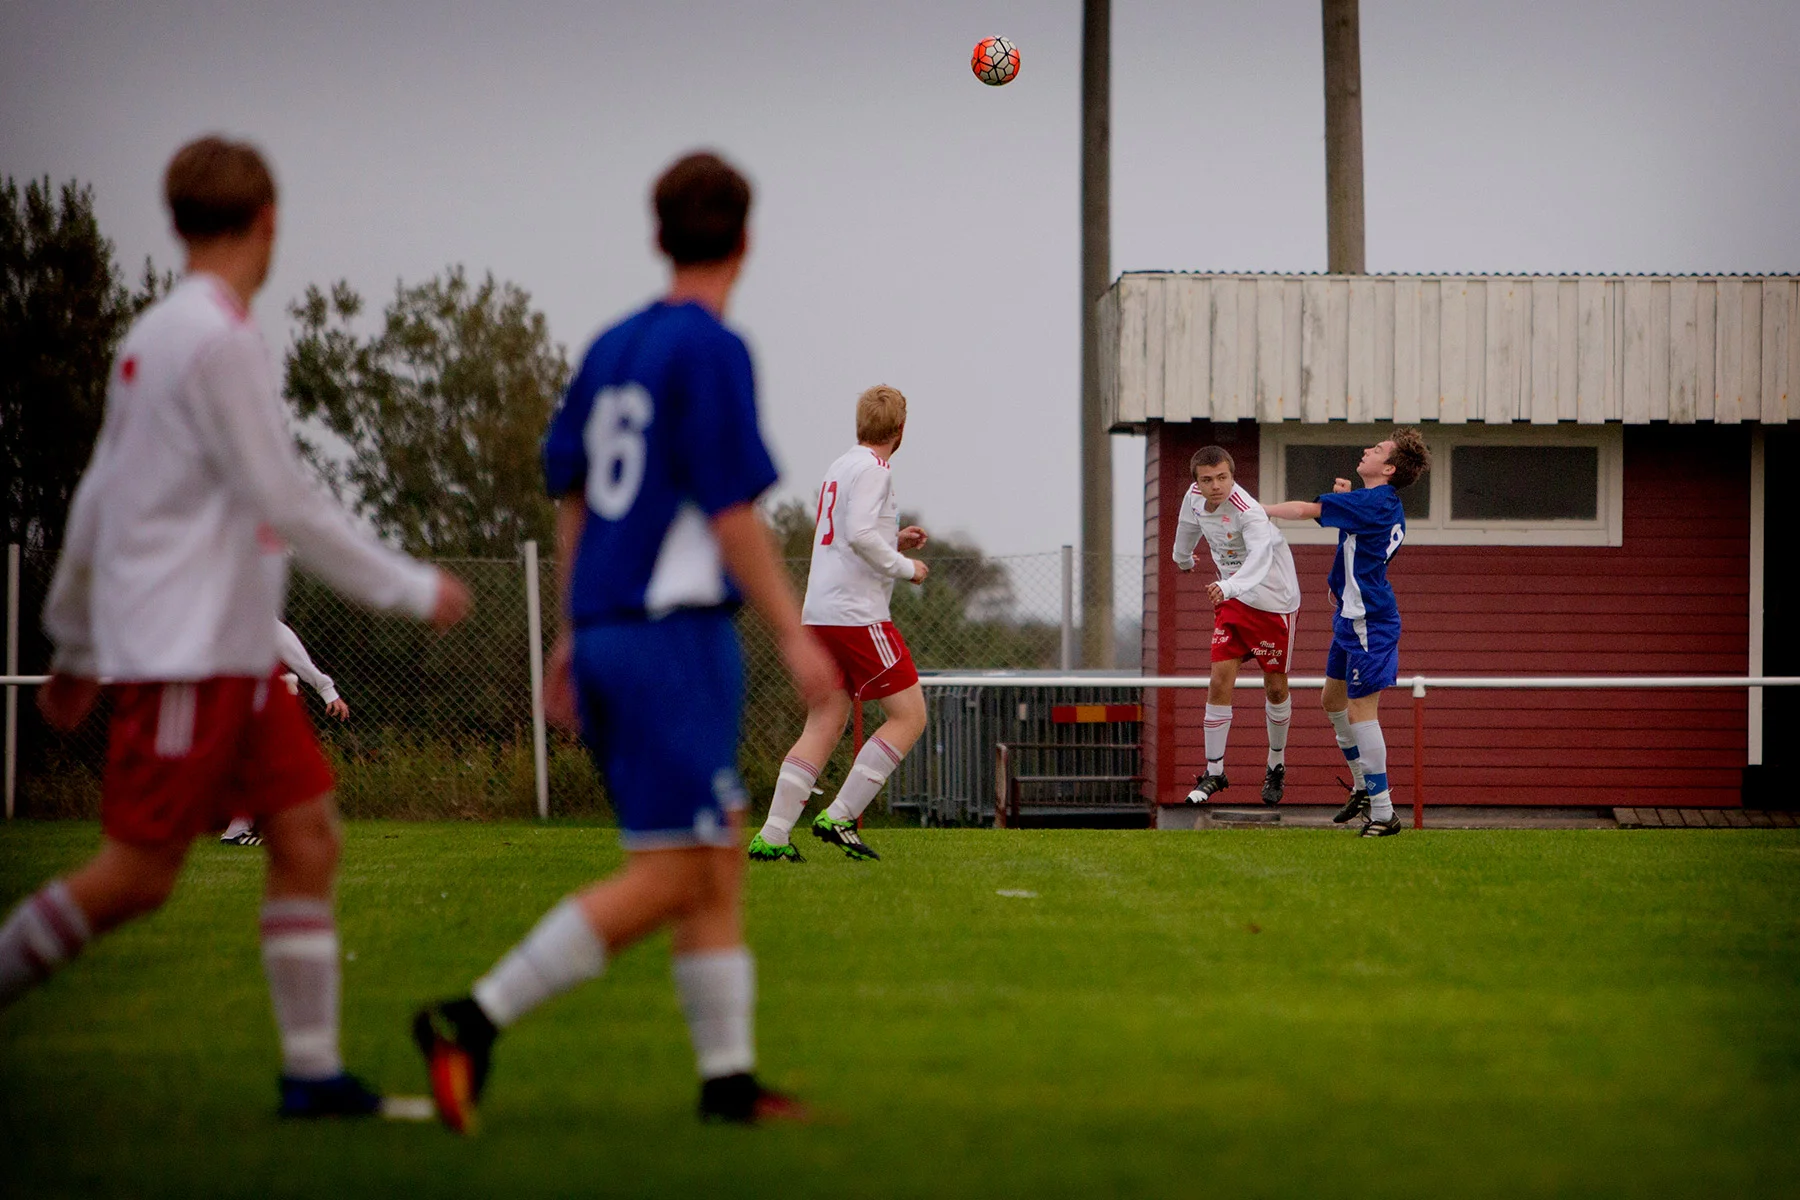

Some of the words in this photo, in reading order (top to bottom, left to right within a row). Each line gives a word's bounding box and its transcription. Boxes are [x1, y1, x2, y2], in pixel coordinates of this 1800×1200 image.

[583, 381, 655, 522] 6
[816, 480, 837, 546] 13
[1383, 523, 1404, 564] 9
[1251, 647, 1267, 656] Taxi
[1268, 649, 1282, 658] AB
[1352, 668, 1359, 680] 2
